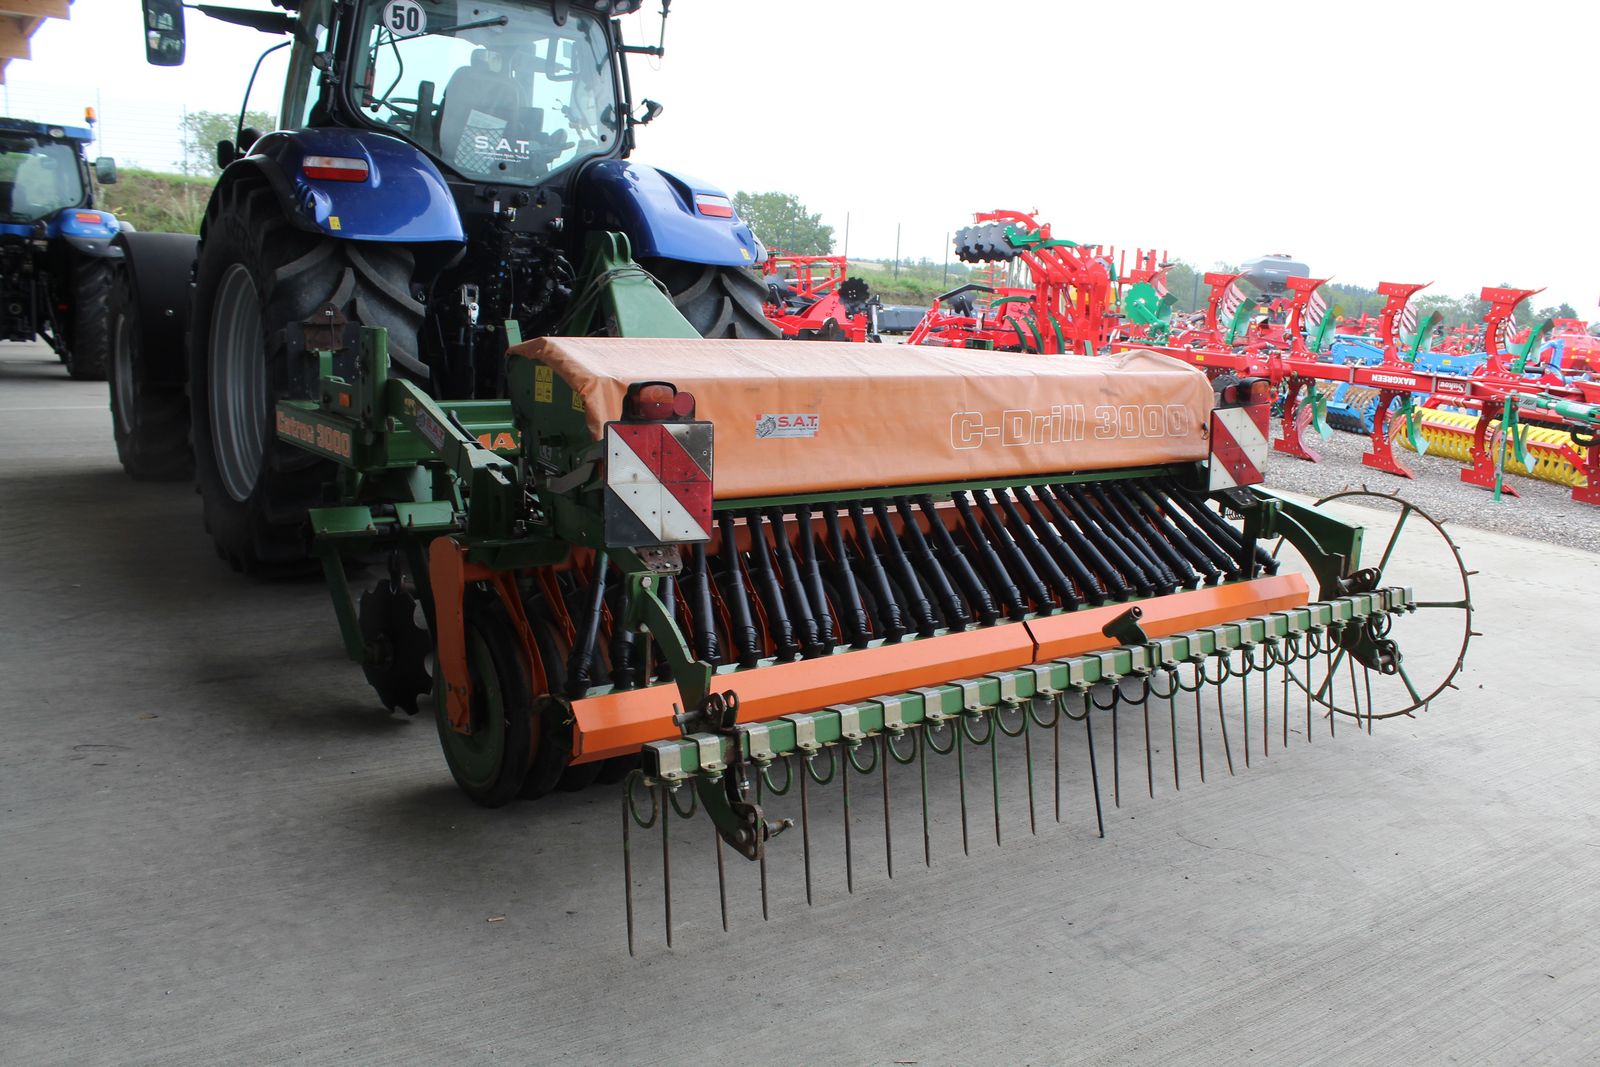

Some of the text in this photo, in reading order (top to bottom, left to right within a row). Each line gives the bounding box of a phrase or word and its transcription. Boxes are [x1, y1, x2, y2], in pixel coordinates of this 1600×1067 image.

[392, 5, 419, 31] 50
[474, 135, 530, 154] S.A.T.
[1371, 374, 1417, 386] MAXGREEN
[777, 415, 818, 427] S.A.T.
[950, 404, 1189, 450] C-Drill 3000
[316, 423, 351, 458] 3000
